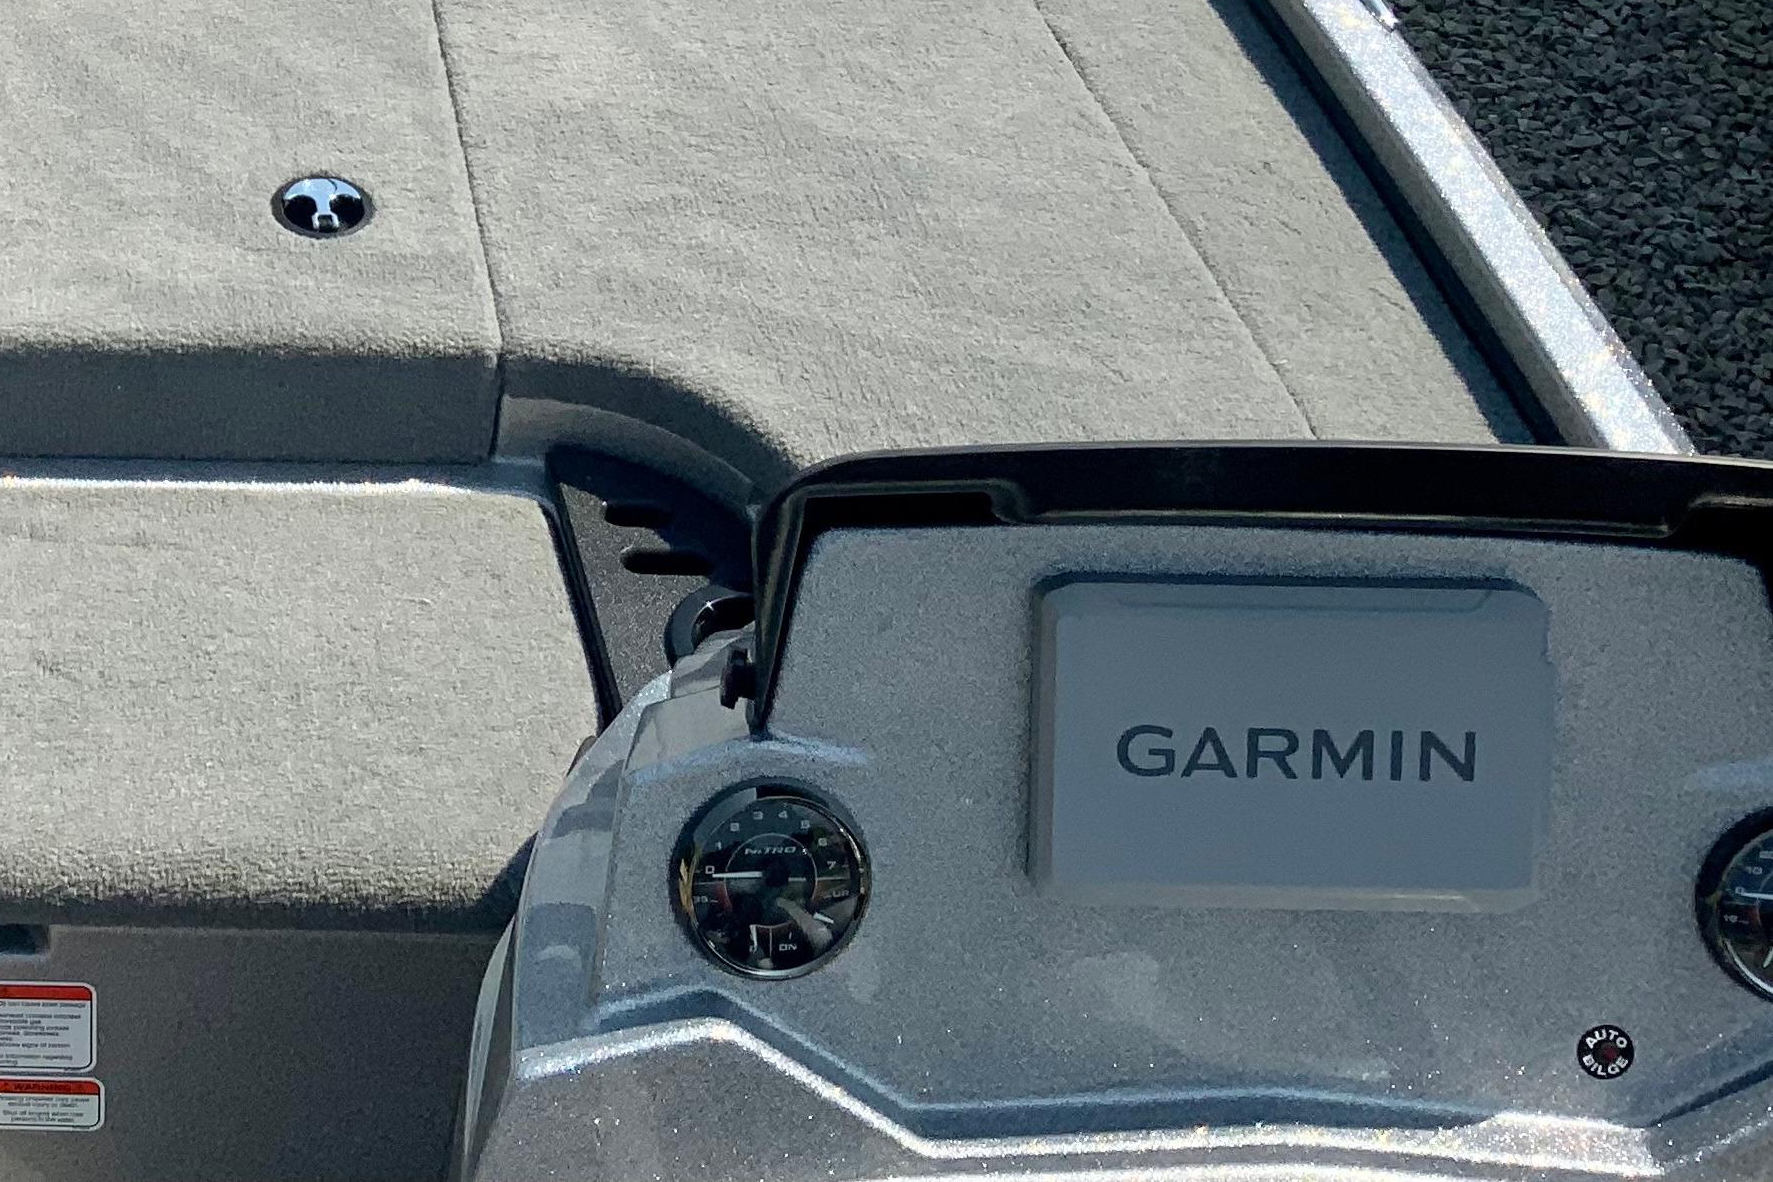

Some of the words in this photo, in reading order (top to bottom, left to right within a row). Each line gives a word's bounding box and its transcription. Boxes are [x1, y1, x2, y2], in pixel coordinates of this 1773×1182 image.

[1116, 724, 1477, 782] GARMIN
[1586, 1029, 1627, 1049] AUTO
[1583, 1054, 1628, 1075] BILGE
